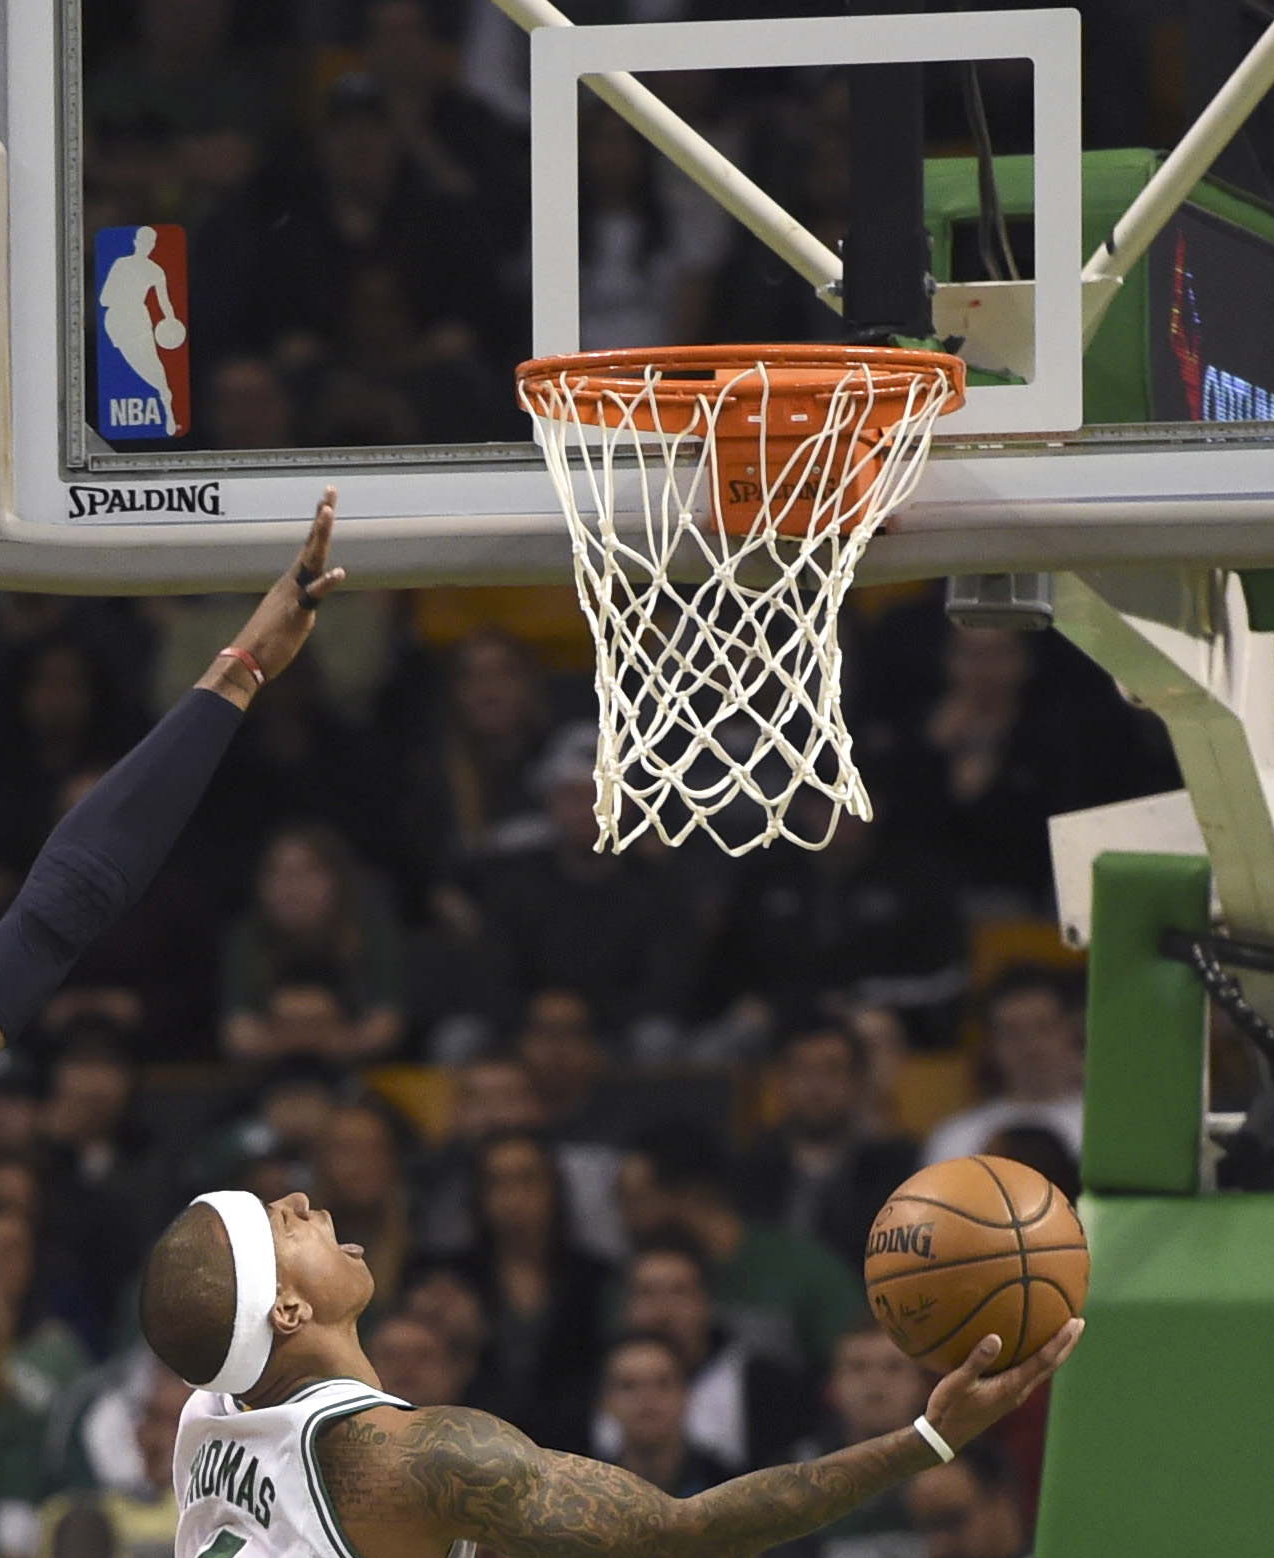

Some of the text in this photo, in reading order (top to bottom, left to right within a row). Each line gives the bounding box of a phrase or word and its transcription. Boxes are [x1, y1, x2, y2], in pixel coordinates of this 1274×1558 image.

[110, 397, 162, 427] NBA
[69, 482, 221, 519] SPALDING
[184, 1439, 276, 1530] HOMAS
